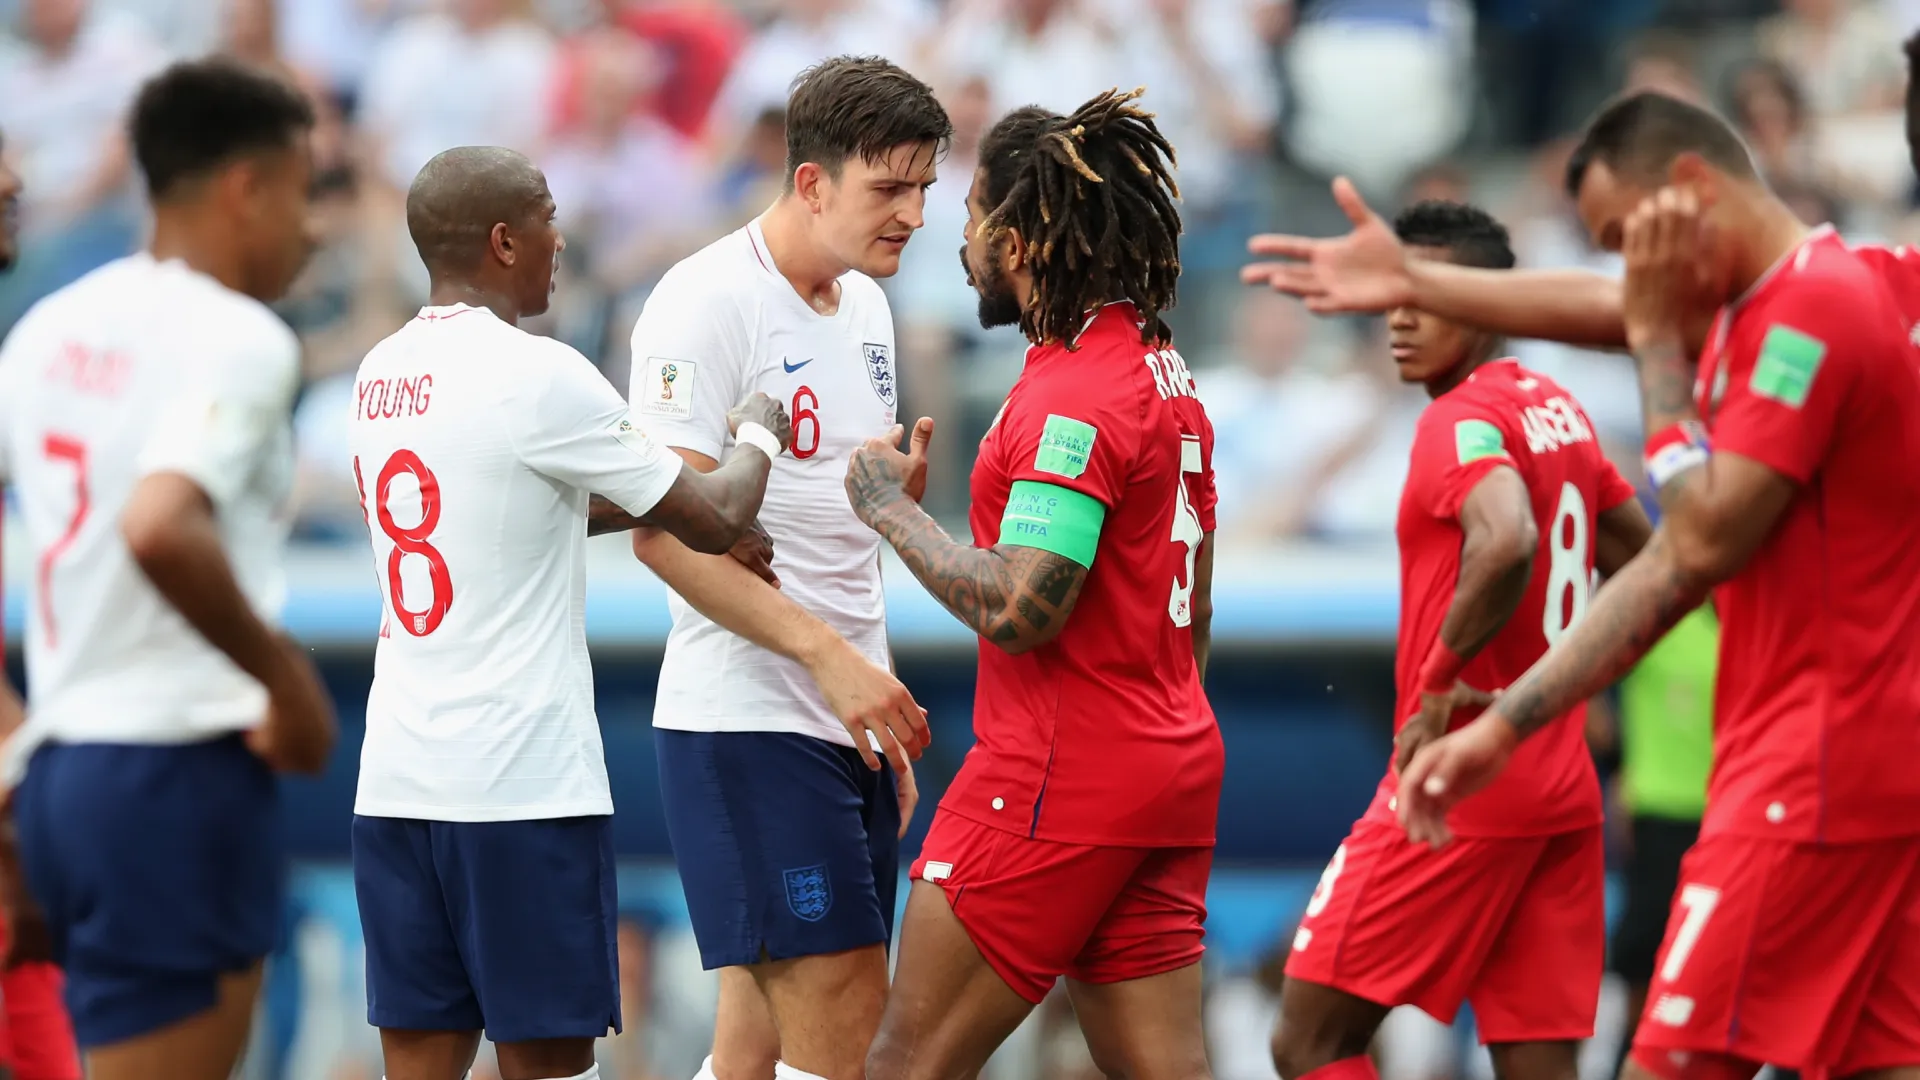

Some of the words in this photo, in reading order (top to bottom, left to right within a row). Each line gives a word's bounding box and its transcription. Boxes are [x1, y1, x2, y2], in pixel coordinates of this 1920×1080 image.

[357, 374, 432, 421] YOUNG
[789, 385, 820, 460] 6
[1066, 454, 1082, 465] FIFA
[41, 430, 90, 648] 7
[1016, 522, 1047, 537] FIFA
[1168, 434, 1203, 628] 5
[1543, 481, 1588, 648] 8
[1661, 884, 1721, 982] 7
